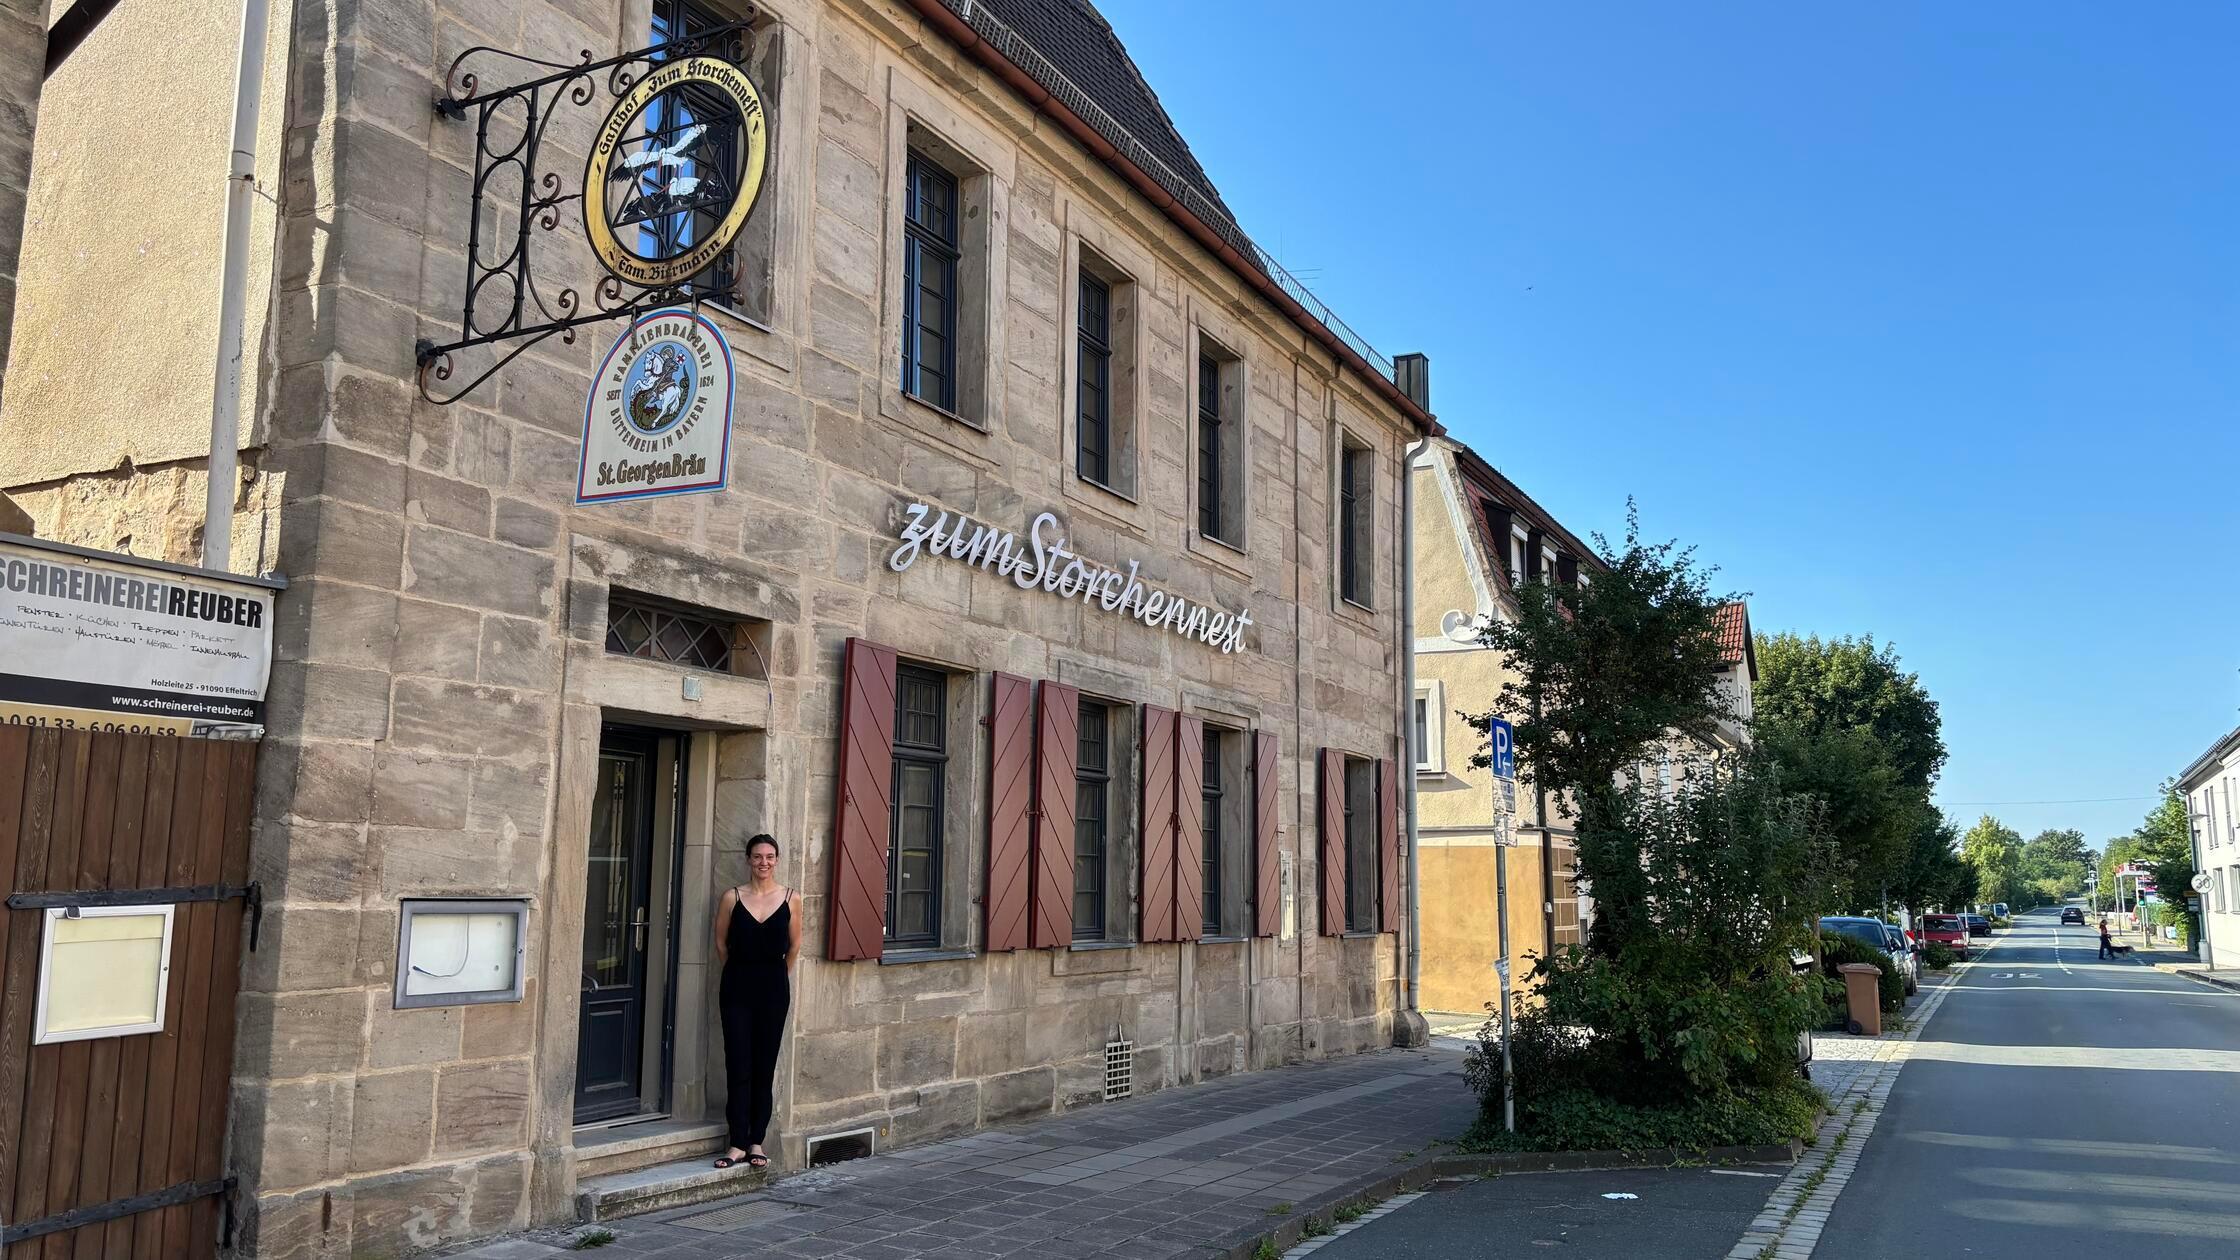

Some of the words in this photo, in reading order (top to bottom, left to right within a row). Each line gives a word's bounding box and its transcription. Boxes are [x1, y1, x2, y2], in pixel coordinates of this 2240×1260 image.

[648, 239, 720, 280] Biermann
[613, 323, 712, 383] FAMILIENBRAUEREI
[606, 389, 621, 401] SEIT
[700, 375, 714, 388] 1624
[610, 407, 658, 453] BUTTENHEIM
[662, 435, 673, 450] IN
[675, 396, 708, 441] BAYERN
[17, 605, 64, 618] FENSTER
[131, 622, 179, 637] TREPPEN
[191, 629, 235, 643] PARKETT
[112, 695, 254, 718] www.schreinerei-reuber.de
[151, 678, 184, 690] Holzleite
[185, 682, 194, 690] 25
[200, 684, 224, 693] 91090
[225, 686, 258, 697] Effeltrich
[1496, 725, 1508, 769] P
[2195, 877, 2211, 890] 30
